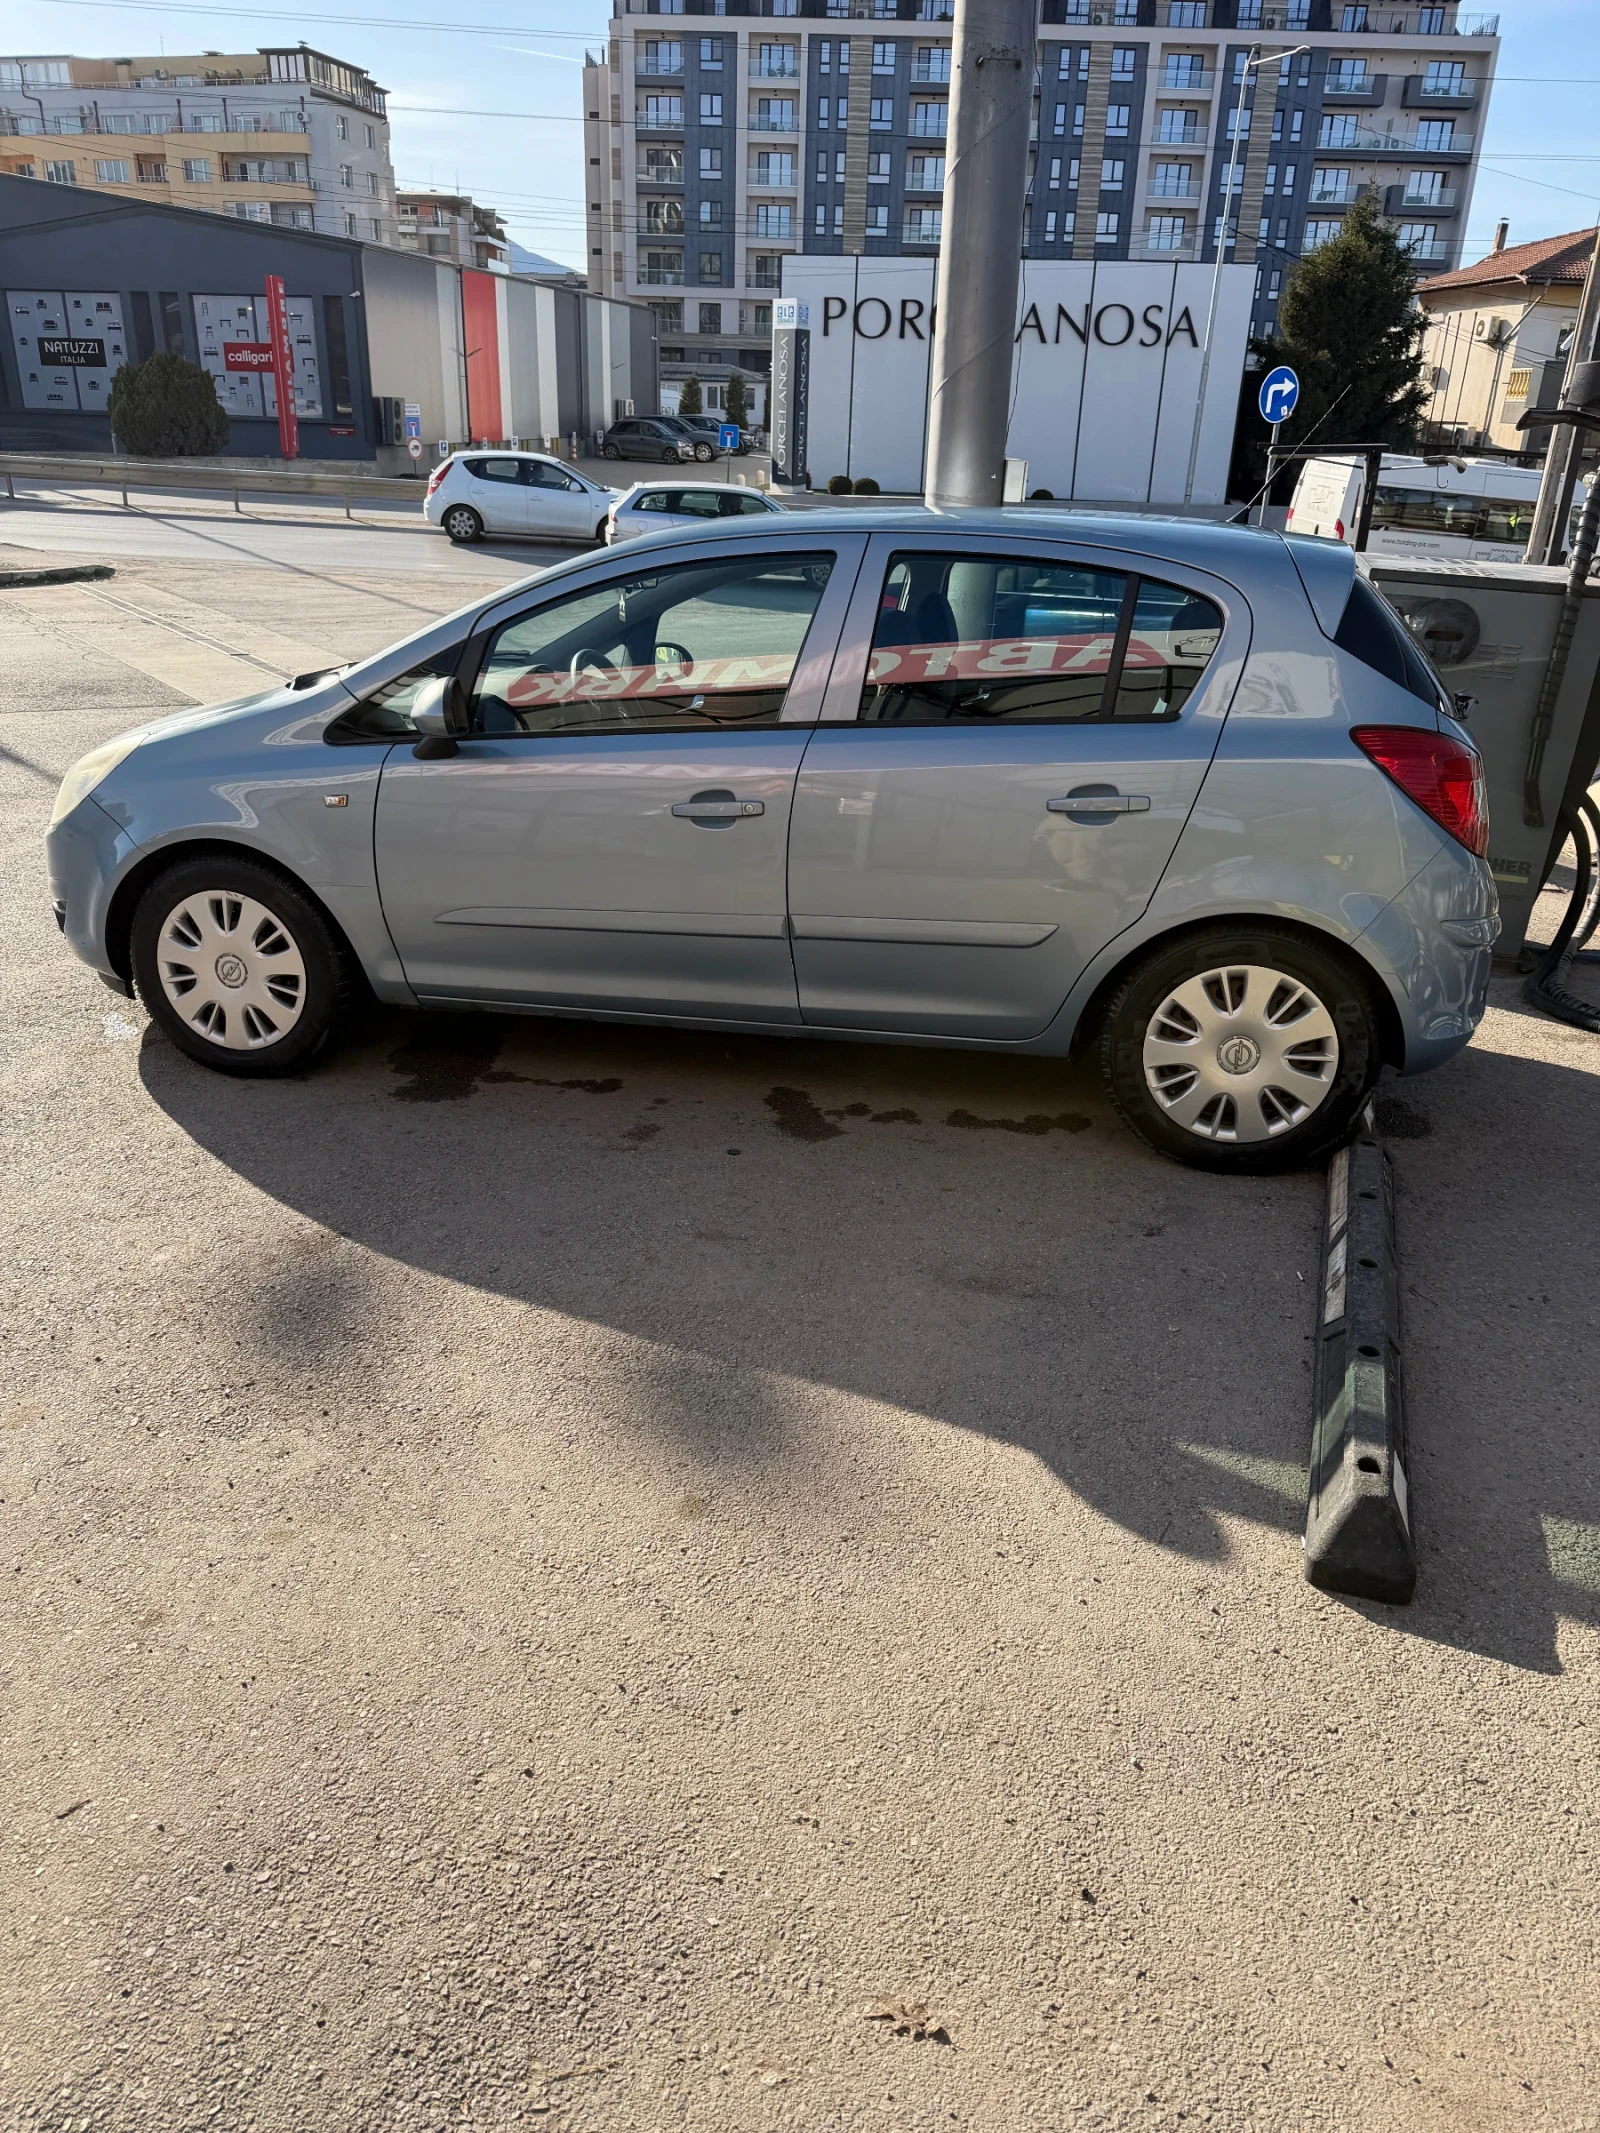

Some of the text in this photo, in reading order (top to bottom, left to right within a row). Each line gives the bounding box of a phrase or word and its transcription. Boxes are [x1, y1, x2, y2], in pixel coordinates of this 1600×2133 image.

[823, 296, 1199, 348] PORANOSA
[44, 341, 99, 354] NATUZZI
[60, 355, 86, 364] ITALIA
[228, 350, 273, 364] calligari
[777, 336, 789, 476] PORCELANOSA
[797, 337, 808, 477] PORCELANOSA
